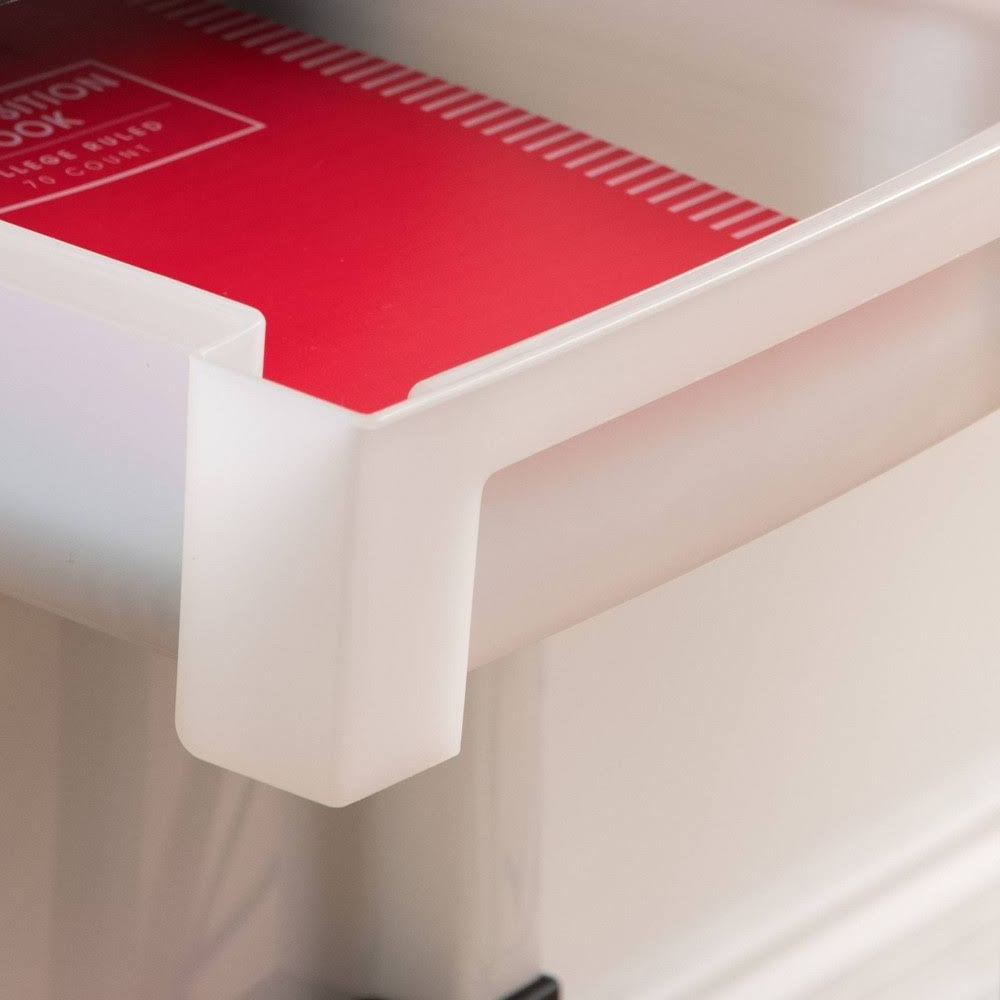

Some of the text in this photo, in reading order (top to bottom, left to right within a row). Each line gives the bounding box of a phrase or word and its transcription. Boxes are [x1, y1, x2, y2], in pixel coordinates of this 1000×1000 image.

[82, 120, 163, 152] RULED
[23, 144, 151, 189] 70 COUNT
